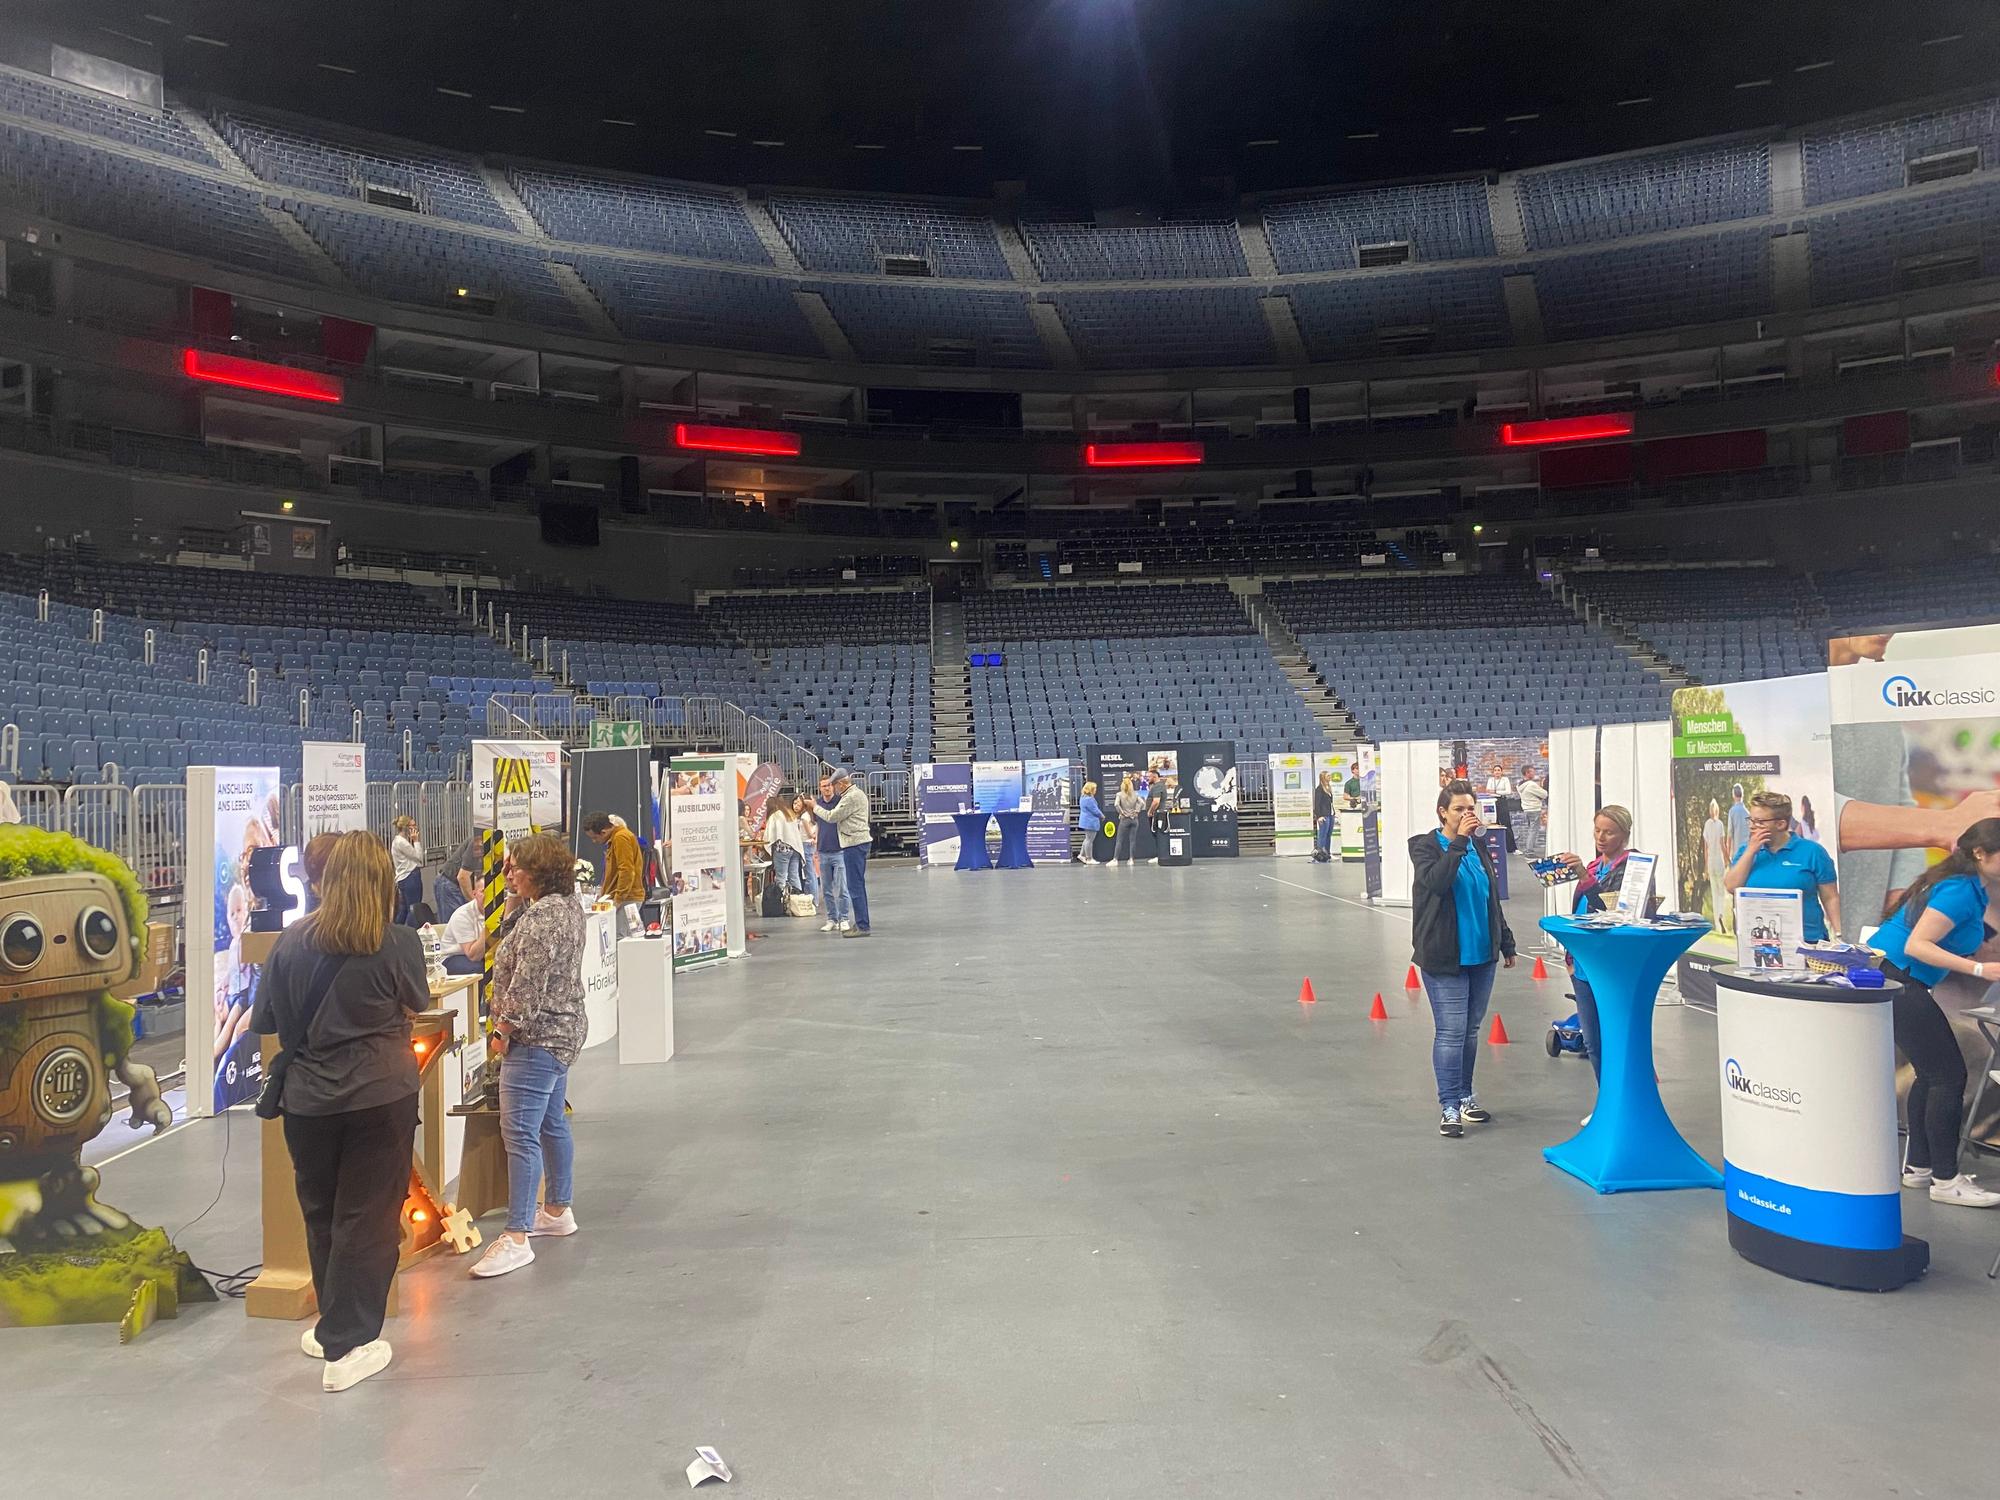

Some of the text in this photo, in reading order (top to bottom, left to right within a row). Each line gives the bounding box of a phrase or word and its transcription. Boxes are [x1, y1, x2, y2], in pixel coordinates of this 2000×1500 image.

[1934, 687, 1995, 705] classic
[1687, 719, 1727, 734] Menschen
[1687, 741, 1696, 754] für
[1698, 740, 1732, 753] Menschen
[1704, 761, 1713, 770] wir
[1713, 761, 1736, 771] schaffen
[1736, 760, 1775, 771] Lebenswerte.
[217, 783, 253, 794] ANSCHLUSS
[308, 783, 338, 792] GERÄUSCHE
[530, 790, 549, 799] ZEN?
[217, 800, 230, 811] ANS
[308, 803, 339, 811] DSCHUNGEL
[677, 803, 721, 813] AUSBILDUNG
[681, 825, 718, 836] TECHNISCHER
[1752, 1082, 1802, 1105] classic
